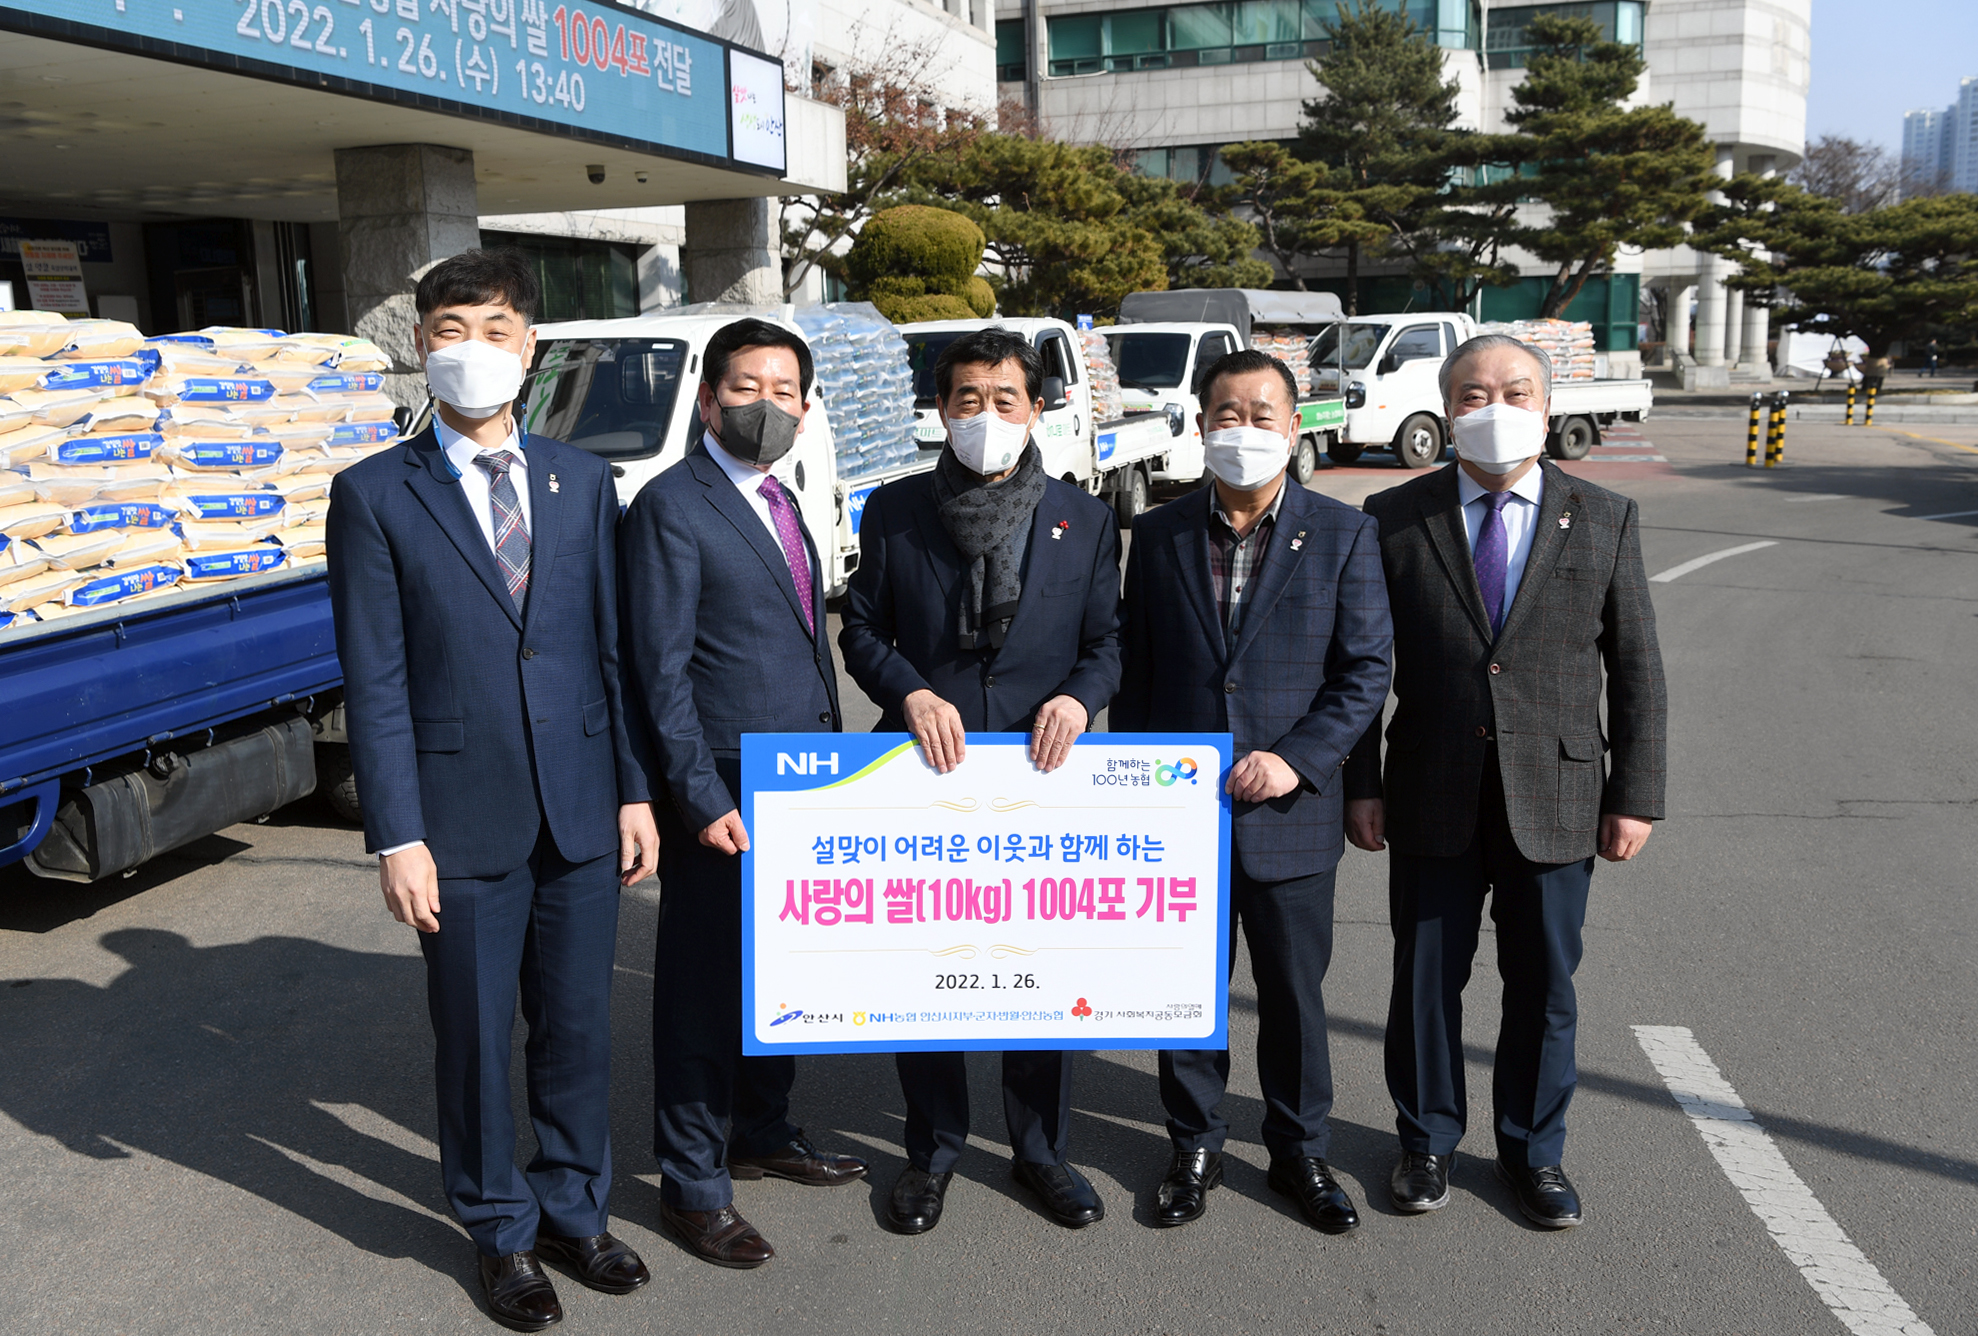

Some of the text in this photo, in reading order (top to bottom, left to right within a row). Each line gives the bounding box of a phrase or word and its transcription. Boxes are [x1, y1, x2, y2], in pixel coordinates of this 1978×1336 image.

[236, 0, 585, 111] 2022. 1. 26. (수) 13:40
[553, 4, 650, 77] 1004포
[653, 38, 692, 96] 전달
[110, 365, 122, 384] 쌀
[236, 383, 248, 399] 쌀
[122, 439, 136, 457] 쌀
[242, 446, 254, 463] 쌀
[244, 498, 256, 514] 쌀
[849, 494, 864, 513] NH
[138, 507, 150, 525] 쌀
[248, 554, 260, 570] 쌀
[140, 571, 154, 590] 쌀
[776, 752, 839, 776] NH
[1106, 758, 1151, 772] 함께하는
[1091, 773, 1150, 787] 100년 농협
[811, 832, 1166, 865] 설맞이 어려운 이웃과 함께 하는
[778, 876, 1198, 927] 사랑의 쌀(10kg) 1004포 기부
[934, 973, 1041, 990] 2022. 1. 26.
[802, 1013, 843, 1024] 안산시
[1094, 1010, 1114, 1021] 경기
